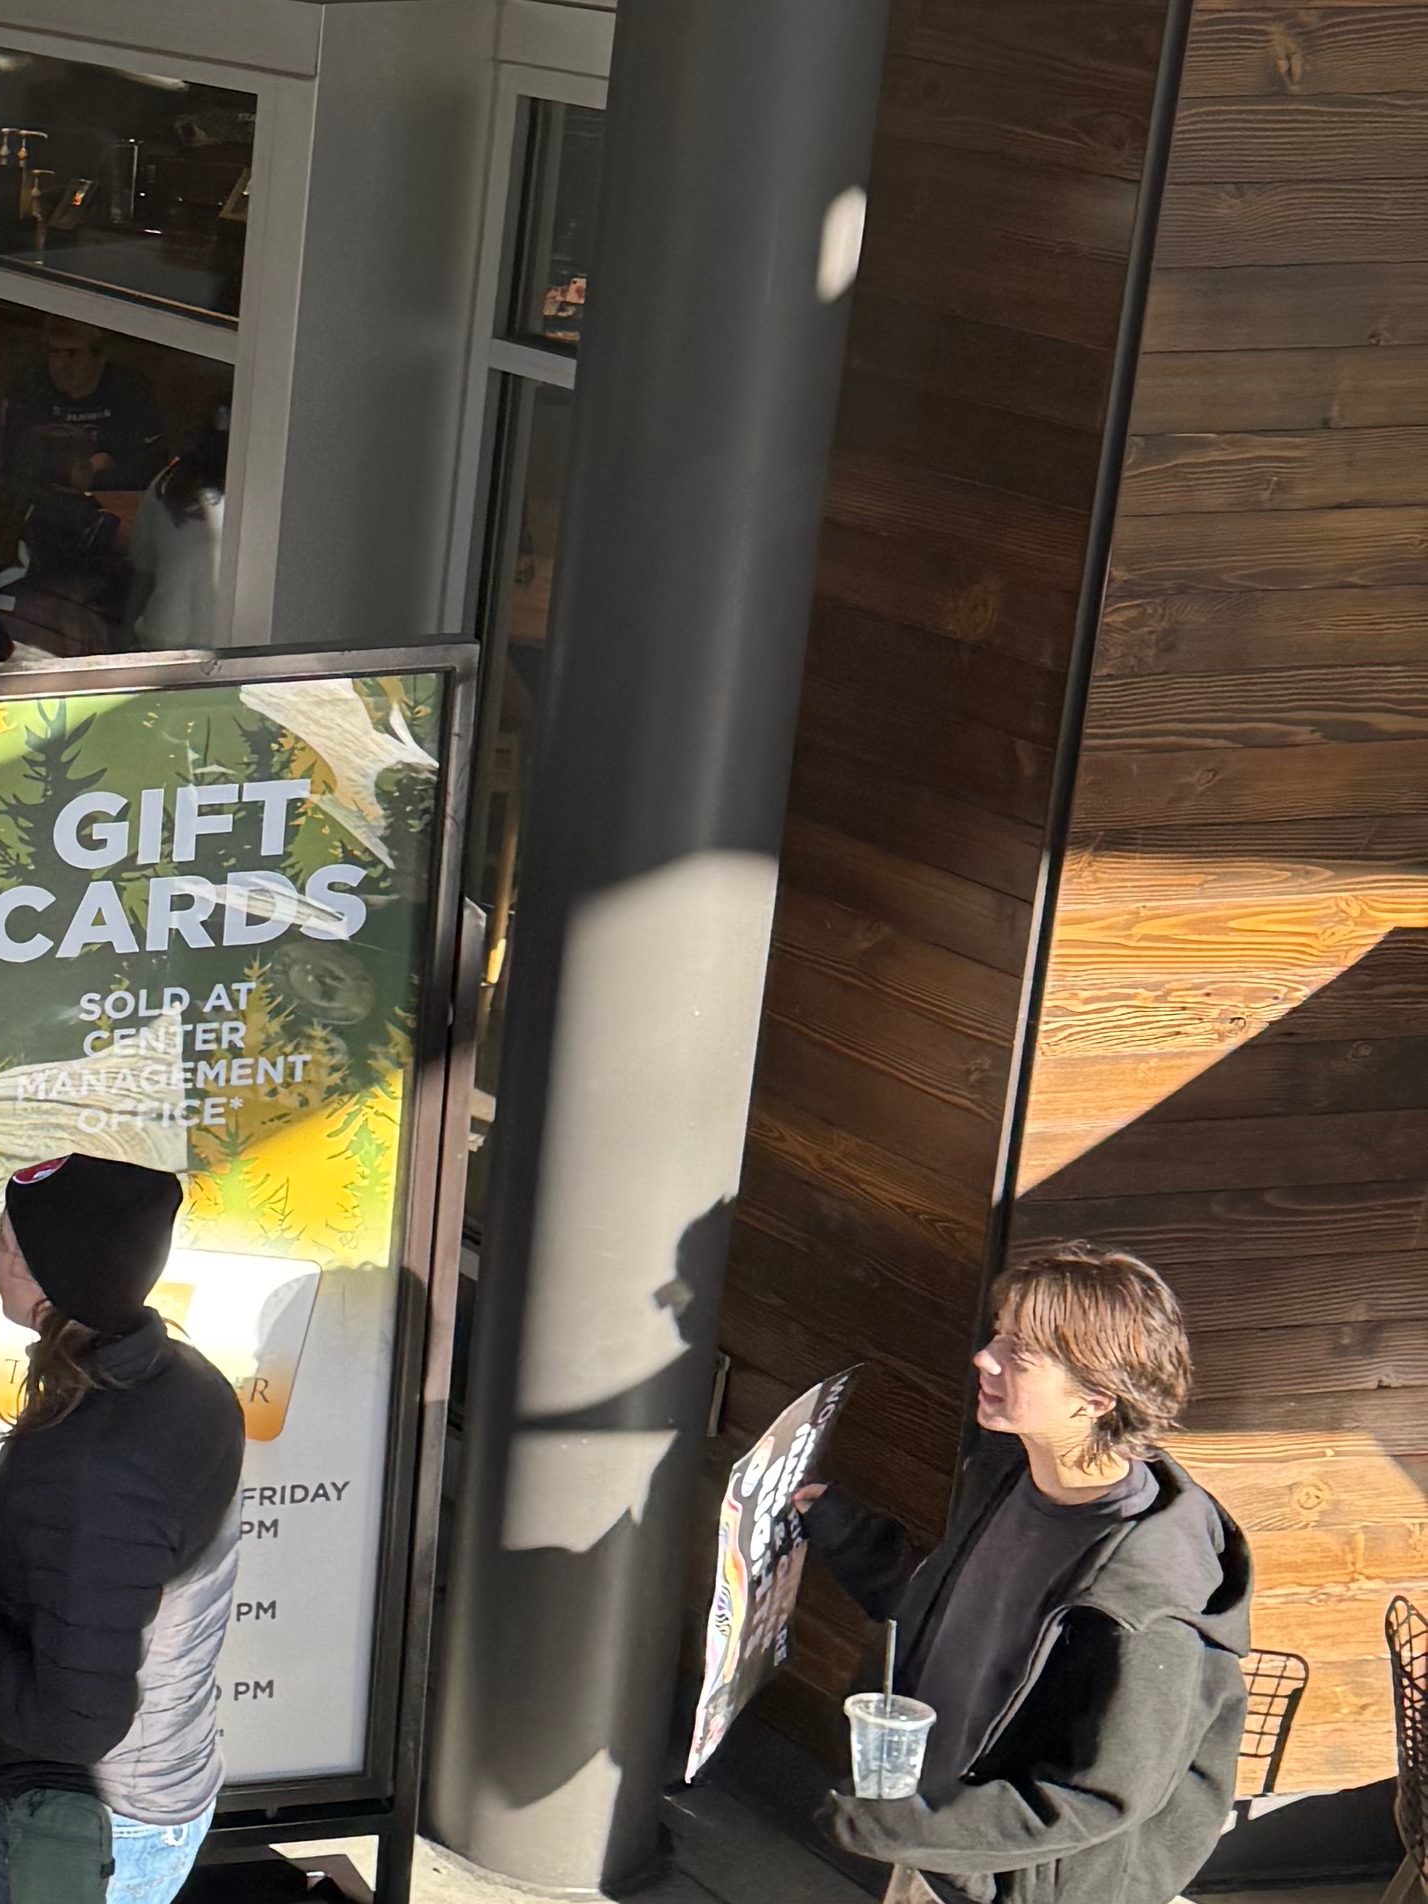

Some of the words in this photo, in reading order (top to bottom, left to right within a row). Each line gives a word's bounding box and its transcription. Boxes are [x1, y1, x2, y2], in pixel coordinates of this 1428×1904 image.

[52, 778, 312, 871] GIFT
[78, 987, 192, 1023] SOLD
[203, 981, 257, 1012] AT
[82, 1021, 247, 1059] CENTER
[17, 1055, 312, 1105] MANAGEMENT
[241, 1480, 352, 1508] FRIDAY
[239, 1519, 280, 1542] PM
[236, 1601, 278, 1624] PM
[233, 1679, 275, 1702] PM
